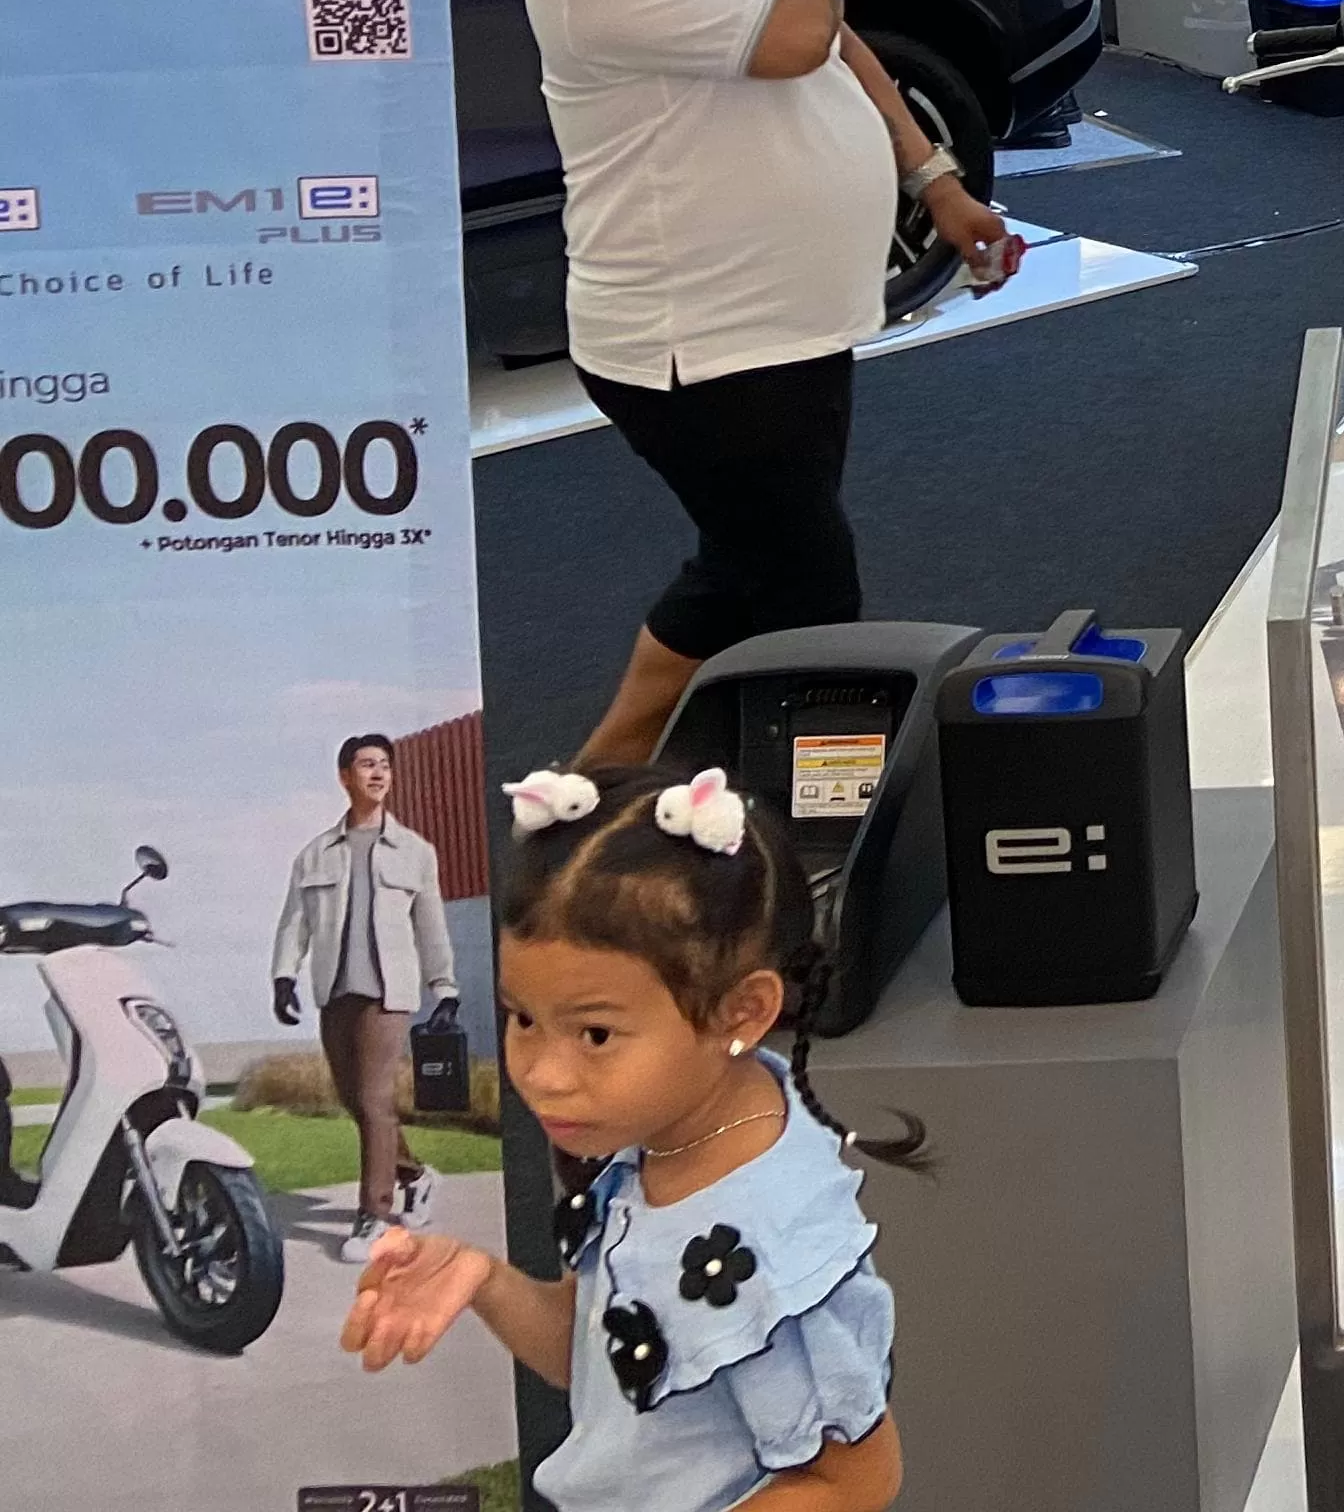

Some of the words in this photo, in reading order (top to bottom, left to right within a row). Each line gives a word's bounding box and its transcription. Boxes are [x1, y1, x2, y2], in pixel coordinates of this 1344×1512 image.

[137, 189, 284, 215] EM1
[310, 186, 369, 209] e:
[257, 224, 382, 244] PLUS
[147, 266, 182, 289] of
[206, 262, 274, 287] Life
[158, 534, 259, 553] Potongan
[263, 531, 321, 548] Tenor
[327, 529, 396, 550] Hingga
[986, 826, 1107, 875] e:
